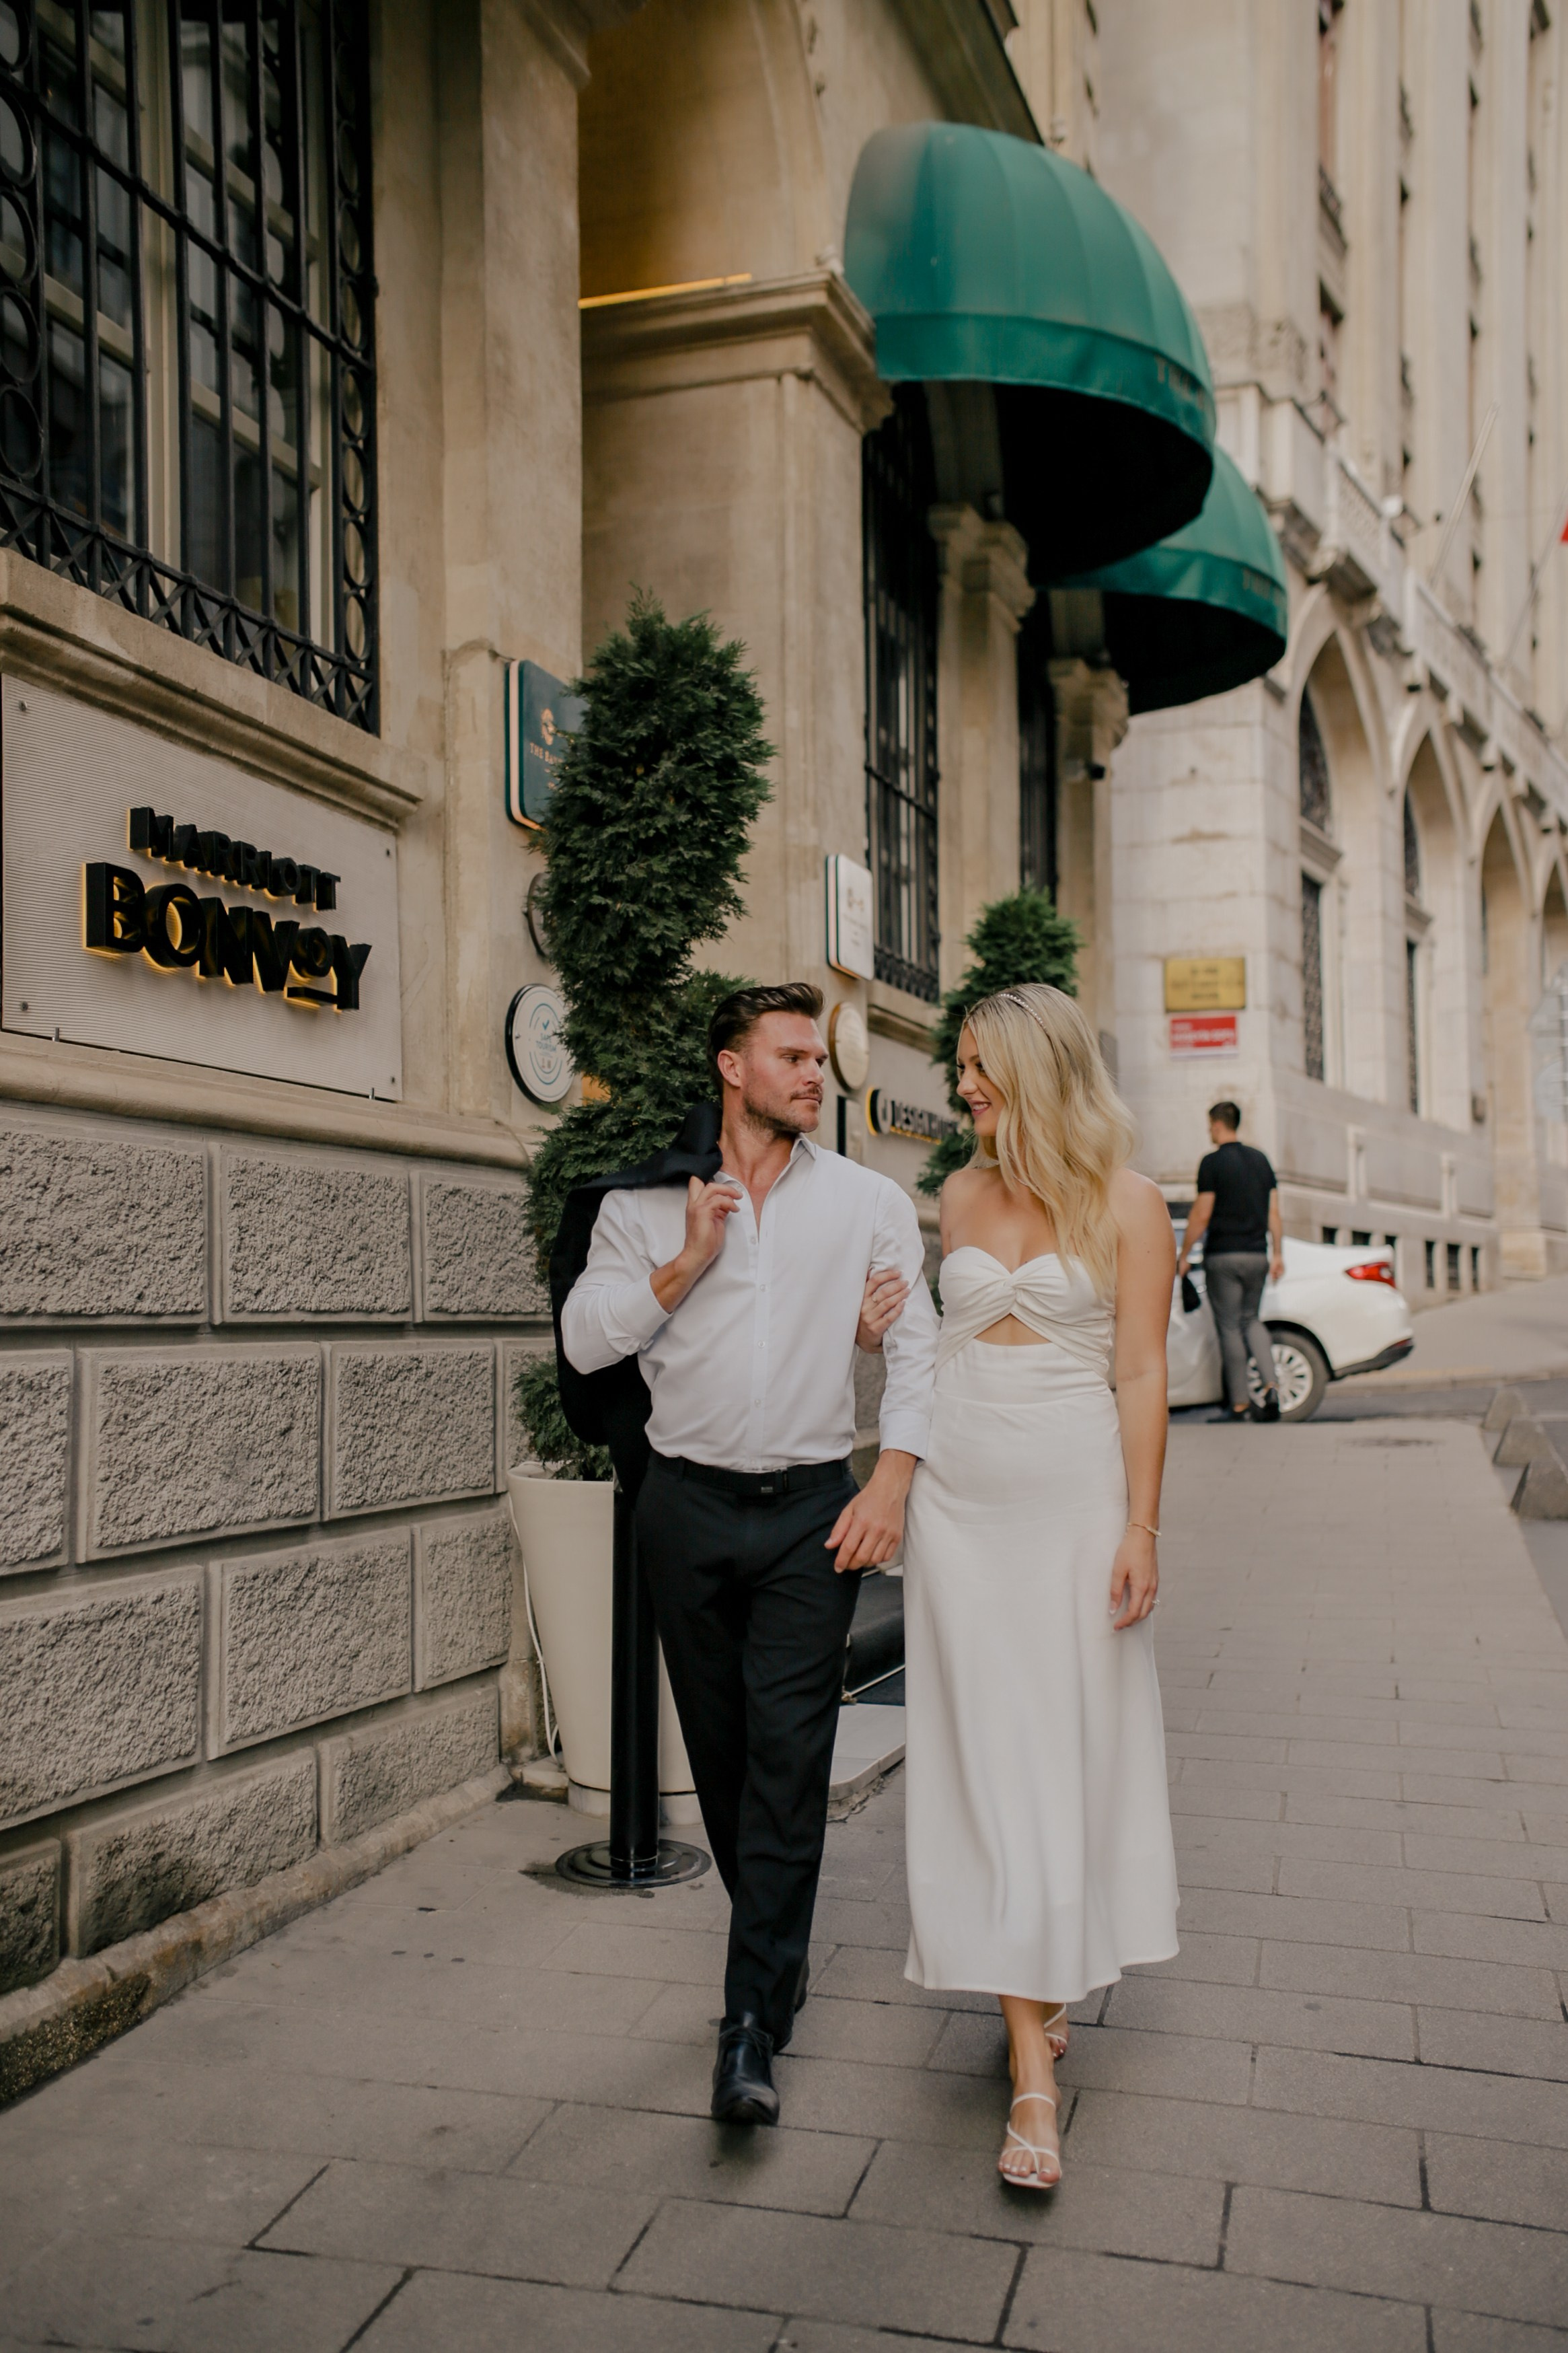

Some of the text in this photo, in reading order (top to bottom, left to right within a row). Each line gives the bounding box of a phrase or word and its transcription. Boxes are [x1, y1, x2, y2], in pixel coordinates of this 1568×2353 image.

[530, 743, 544, 759] THE
[128, 807, 342, 911] MARRIOTT
[85, 862, 371, 1010] BONVOY
